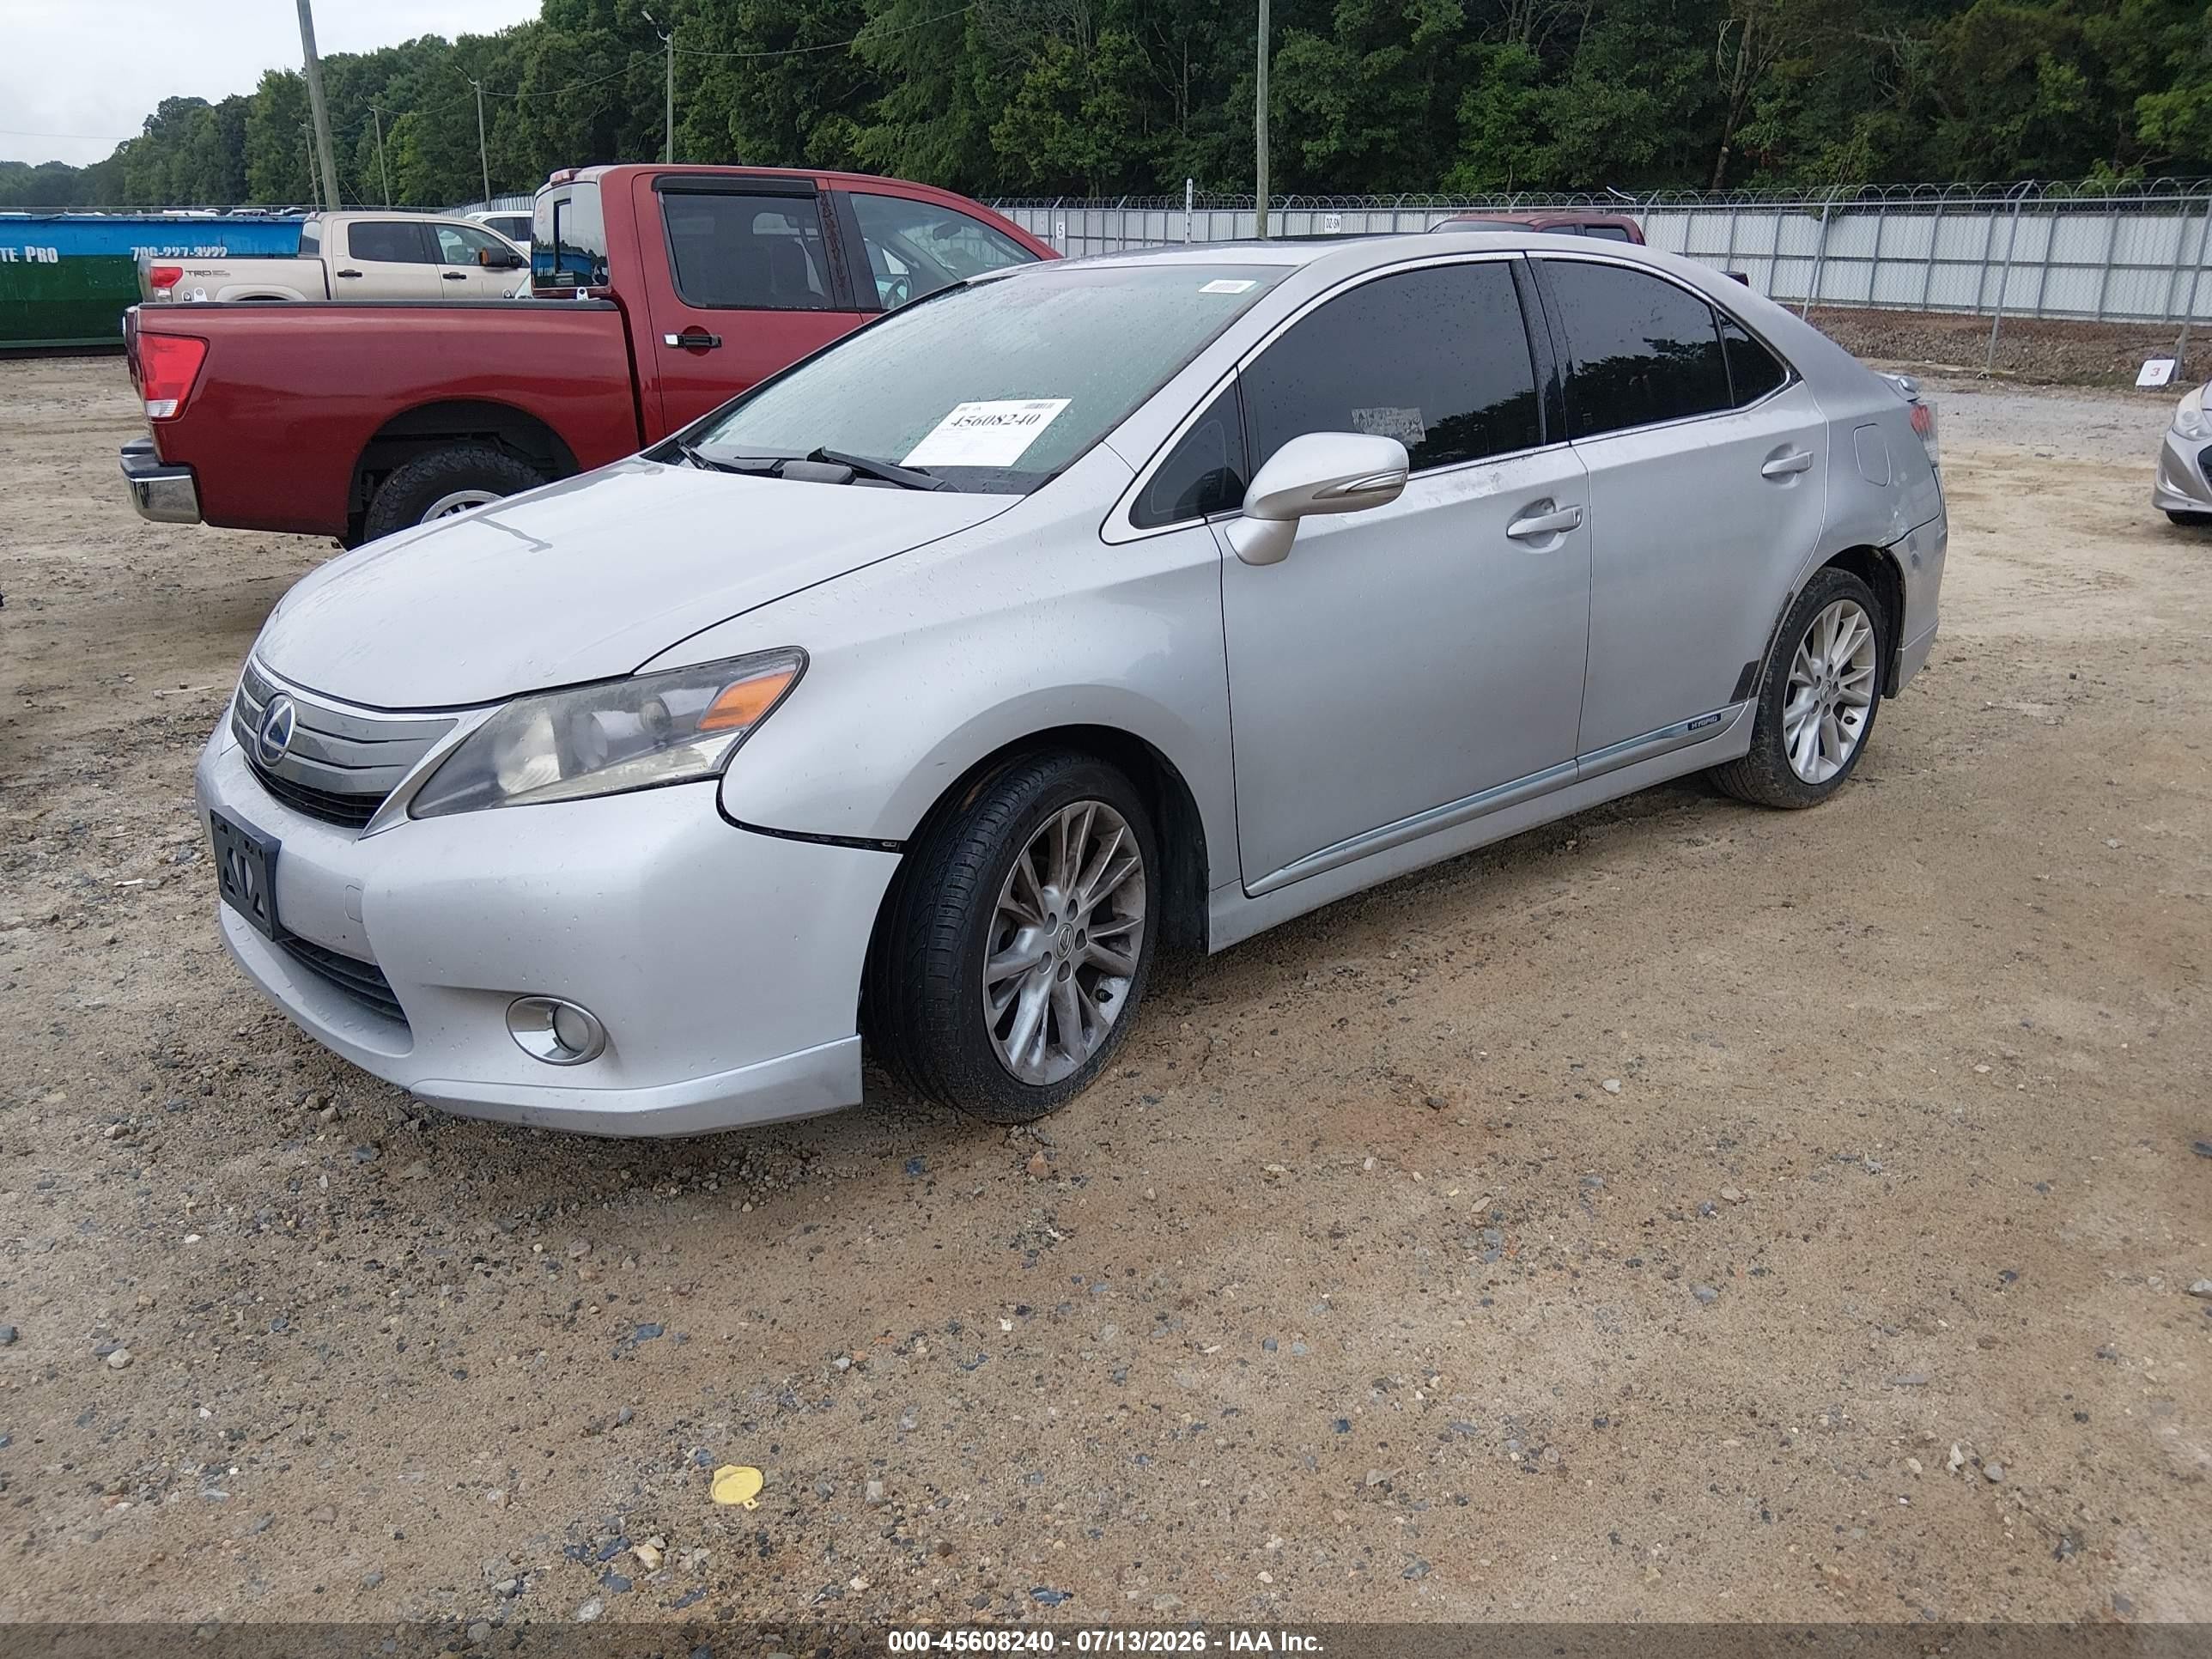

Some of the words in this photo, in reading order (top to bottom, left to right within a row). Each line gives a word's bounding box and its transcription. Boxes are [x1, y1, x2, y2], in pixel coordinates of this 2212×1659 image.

[1058, 224, 1063, 236] 5
[2150, 367, 2160, 377] 3
[951, 413, 1042, 428] 45608240
